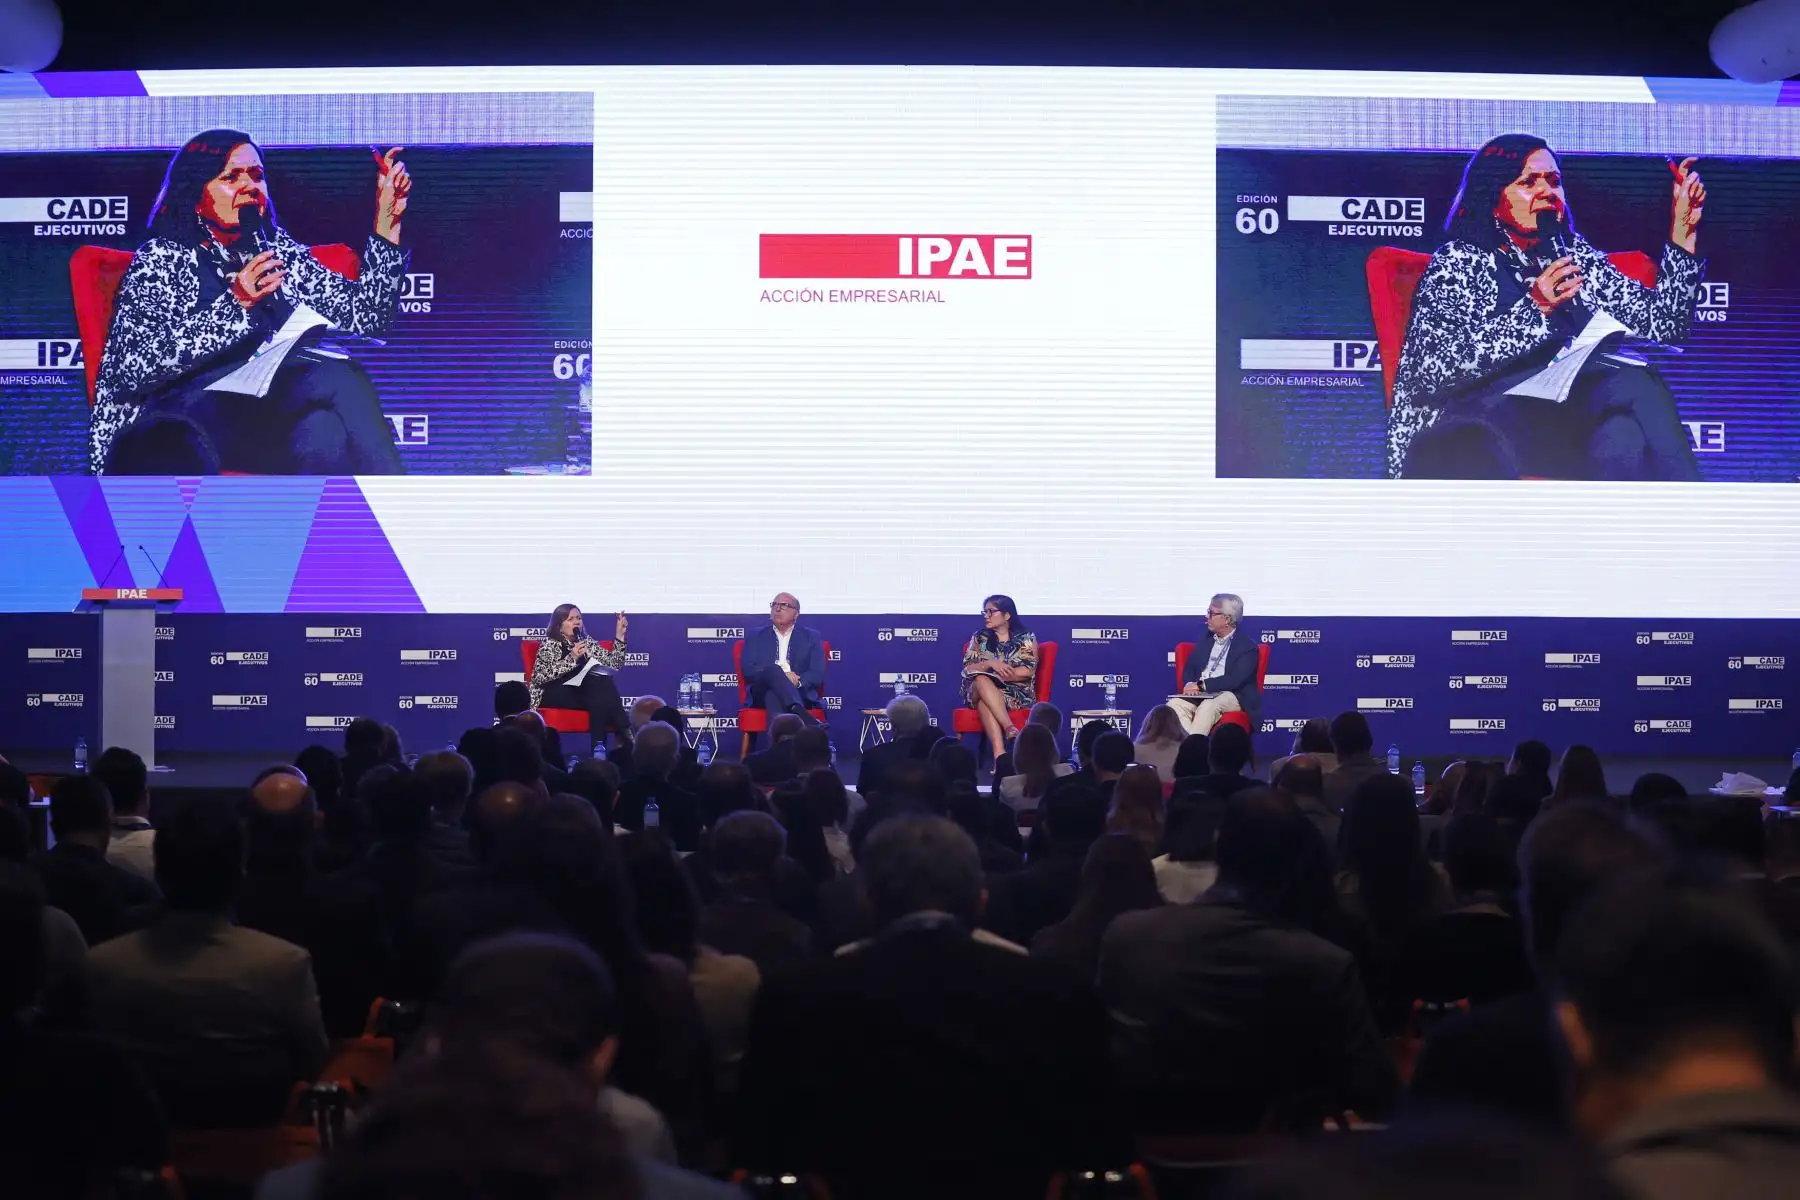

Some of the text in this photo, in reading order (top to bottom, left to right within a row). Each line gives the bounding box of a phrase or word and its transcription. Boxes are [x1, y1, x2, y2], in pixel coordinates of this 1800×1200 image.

[1236, 194, 1278, 203] EDICIÓN
[47, 199, 126, 220] CADE
[1341, 199, 1423, 220] CADE
[1235, 208, 1279, 234] 60
[34, 224, 126, 236] EJECUTIVOS
[1328, 225, 1423, 236] EJECUTIVOS
[899, 237, 1028, 276] IPAE
[760, 287, 946, 303] ACCIÓN EMPRESARIAL
[38, 341, 83, 366] IPA
[1333, 342, 1382, 368] IPA
[0, 375, 68, 385] MPRESARIAL
[1241, 374, 1364, 387] ACCIÓN EMPRESARIAL
[117, 588, 148, 599] IPAE
[334, 628, 361, 636] IPAE
[493, 632, 507, 640] 60
[716, 629, 743, 637] IPAE
[878, 632, 892, 641] 60
[1100, 630, 1127, 638] IPAE
[1479, 631, 1506, 640] IPAE
[1261, 634, 1275, 643] 60
[1636, 636, 1650, 644] 60
[55, 649, 81, 657] IPAE
[429, 651, 456, 659] IPAE
[210, 656, 224, 665] 60
[1573, 654, 1599, 662] IPAE
[1356, 659, 1370, 668] 60
[1728, 661, 1741, 669] 60
[304, 677, 318, 686] 60
[908, 674, 935, 682] IPAE
[1290, 676, 1317, 684] IPAE
[1664, 677, 1690, 685] IPAE
[1069, 679, 1084, 688] 60
[1449, 680, 1463, 689] 60
[26, 698, 40, 706] 60
[58, 694, 83, 702] CADE
[240, 696, 267, 704] IPAE
[399, 700, 413, 709] 60
[1385, 699, 1412, 707] IPAE
[1542, 703, 1556, 711] 60
[1756, 700, 1781, 708] IPAE
[334, 717, 354, 725] IPA
[1478, 720, 1504, 728] IPAE
[1634, 724, 1648, 732] 60
